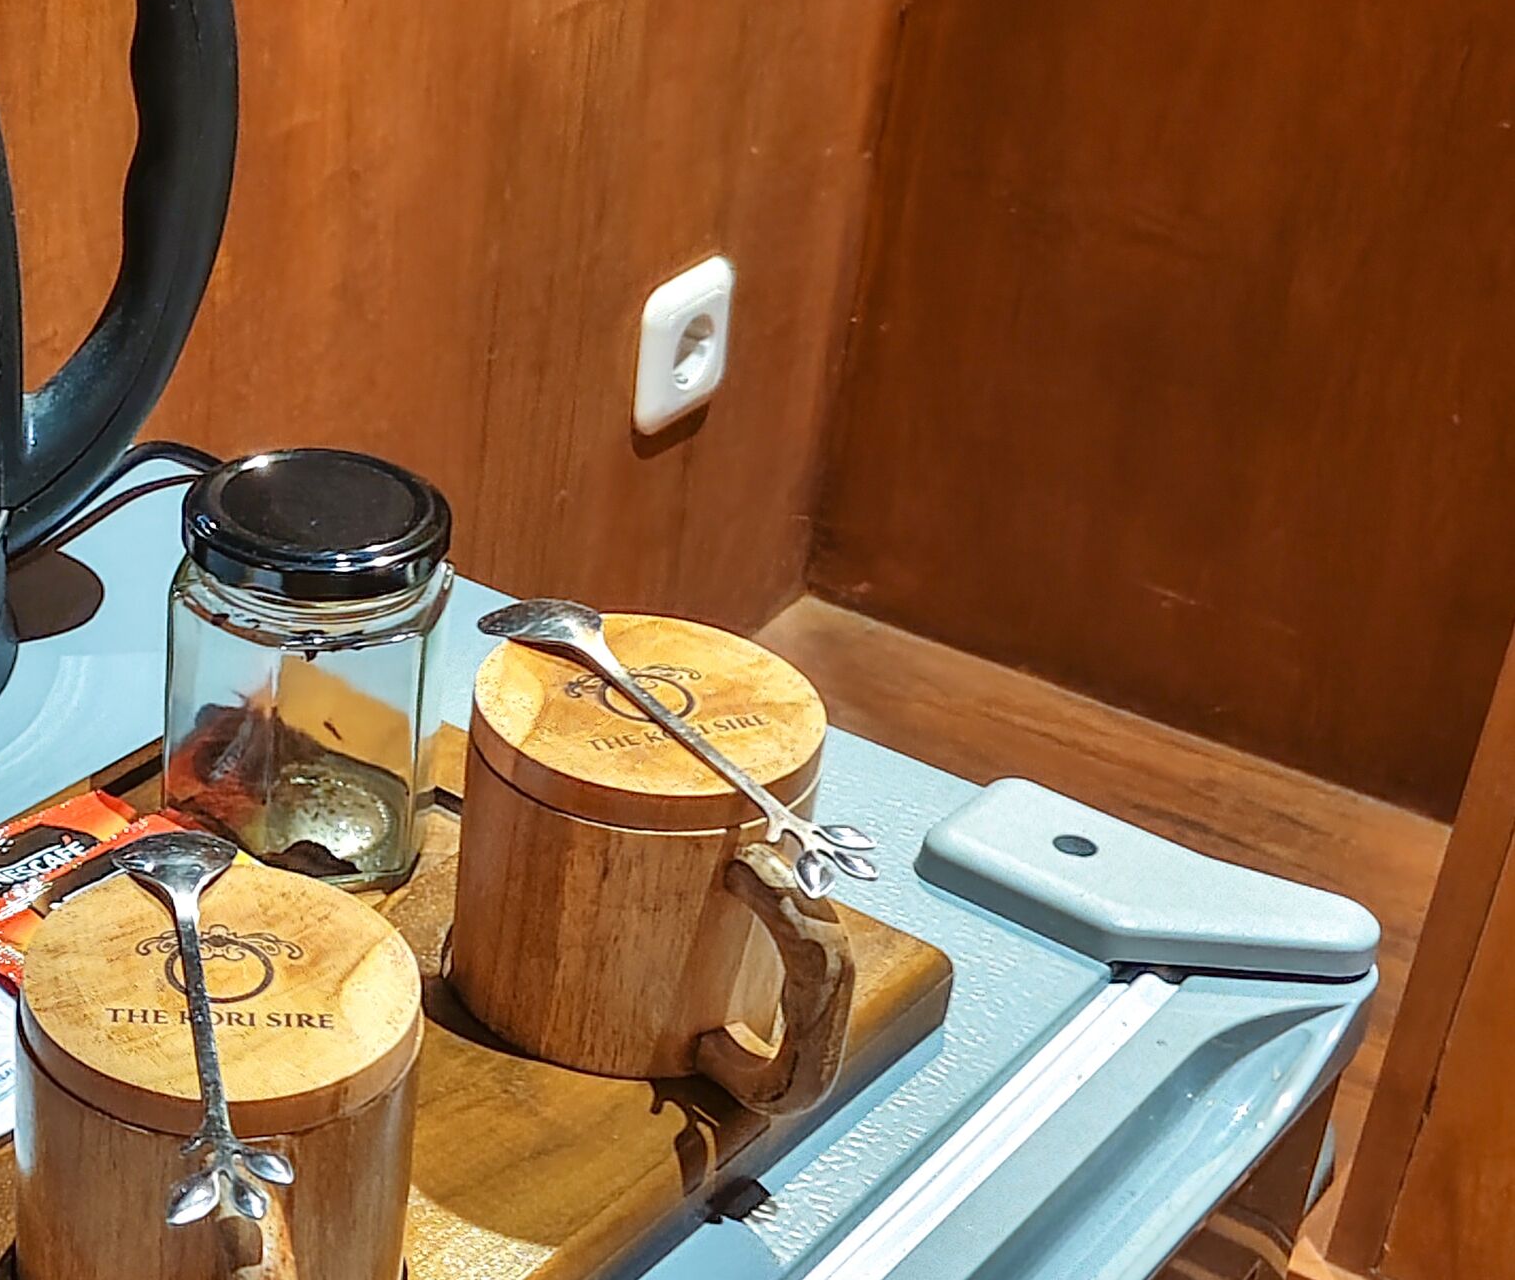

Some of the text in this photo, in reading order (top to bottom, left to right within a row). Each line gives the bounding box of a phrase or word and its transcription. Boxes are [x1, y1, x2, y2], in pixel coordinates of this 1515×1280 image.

[588, 732, 641, 751] THE
[713, 714, 770, 732] SIRE
[105, 1007, 169, 1024] THE
[266, 1012, 335, 1030] SIRE
